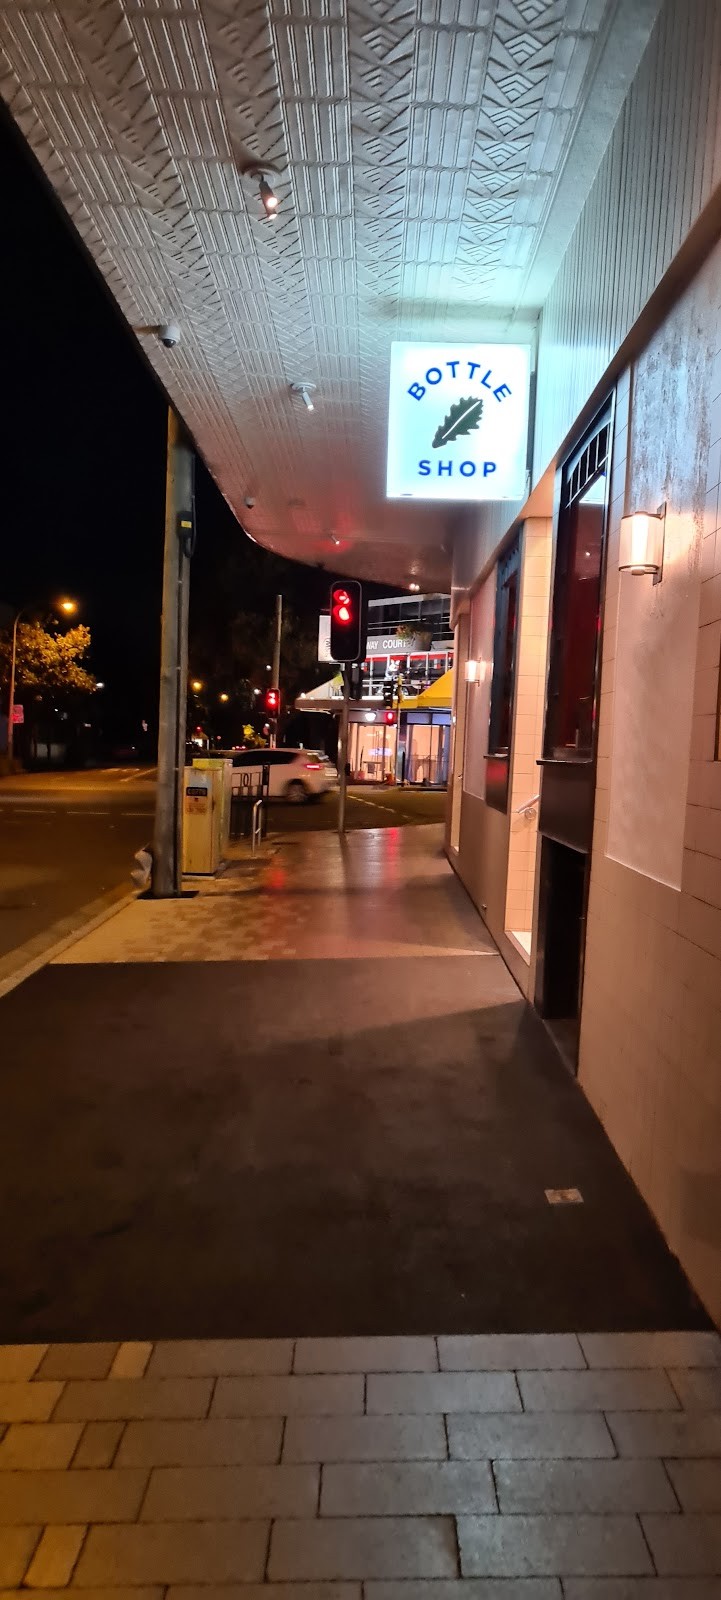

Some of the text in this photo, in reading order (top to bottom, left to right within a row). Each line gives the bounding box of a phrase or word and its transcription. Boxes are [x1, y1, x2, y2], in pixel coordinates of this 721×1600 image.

[407, 361, 512, 402] BOTTLE
[418, 459, 497, 477] SHOP
[382, 639, 406, 649] COURT
